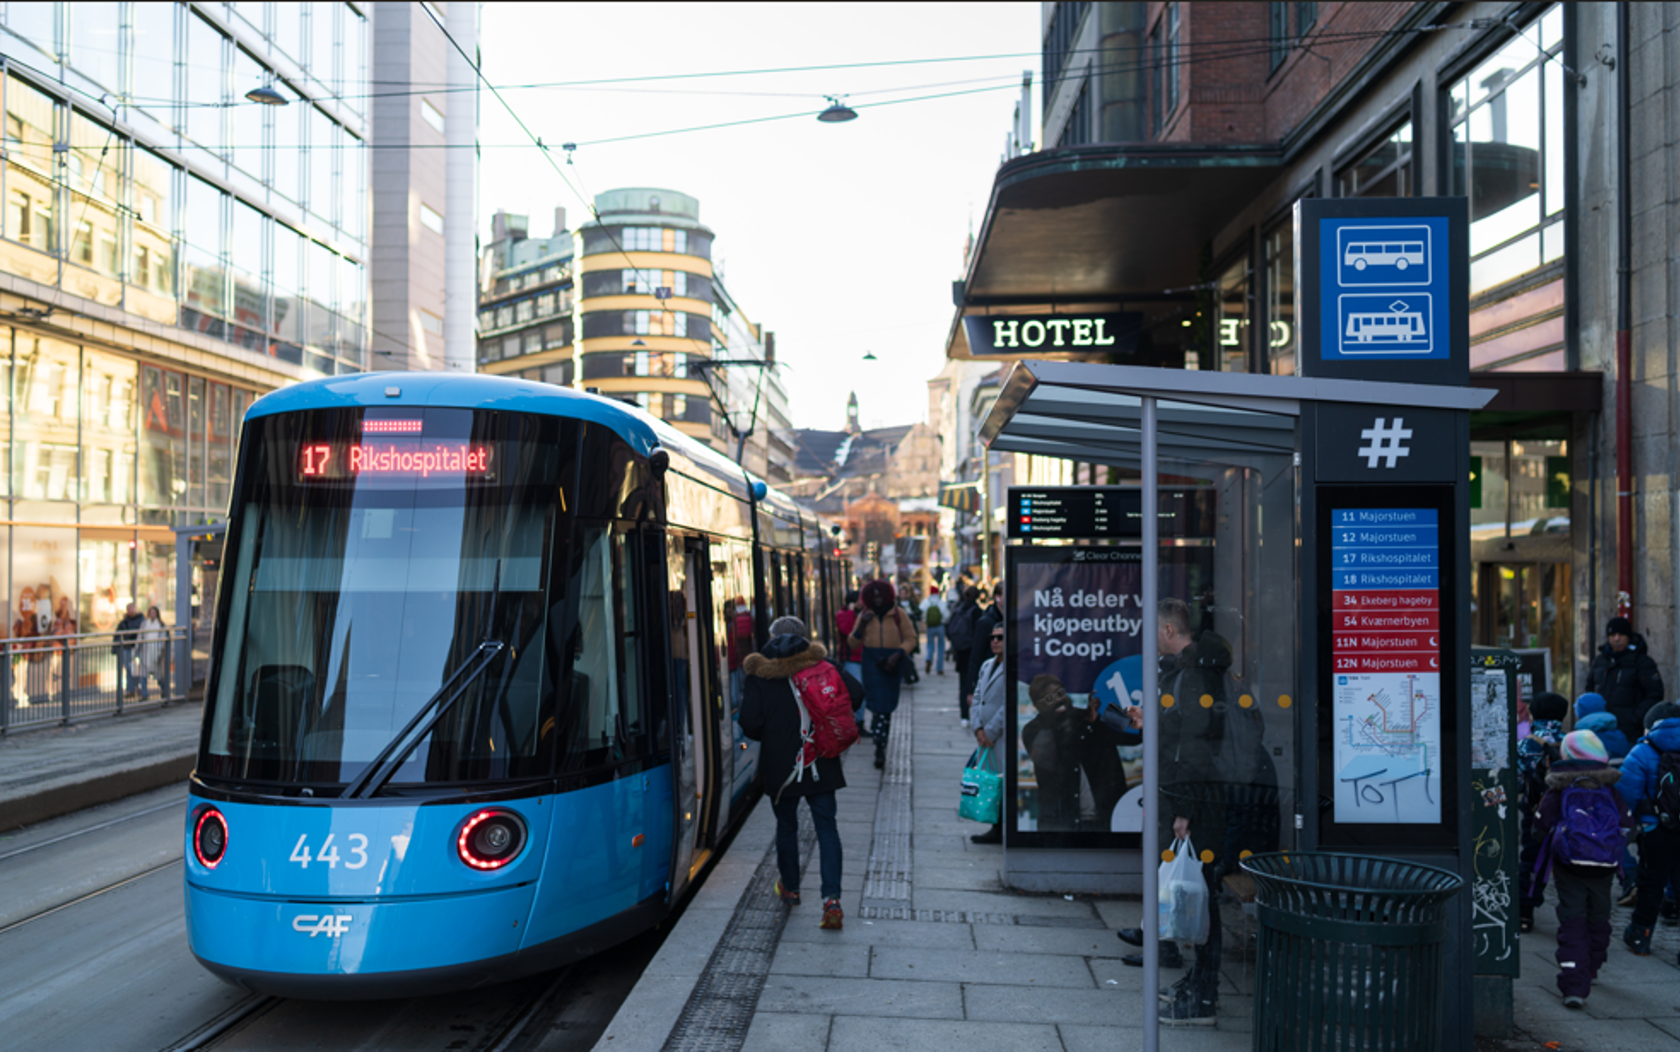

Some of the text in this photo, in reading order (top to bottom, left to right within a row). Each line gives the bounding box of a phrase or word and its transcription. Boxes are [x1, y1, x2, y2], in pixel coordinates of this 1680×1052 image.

[993, 318, 1115, 347] HOTEL
[303, 445, 487, 478] 17 Rikshospitalet
[1342, 511, 1416, 523] 11 Majorstuen
[1342, 532, 1417, 544] 12 Majorstuen
[1086, 551, 1143, 560] Clear Channe
[1343, 552, 1432, 564] 17 Rikshospitalet
[1343, 573, 1432, 585] 18 Rikshospitalet
[1033, 587, 1143, 608] Nå deler v
[1343, 595, 1433, 606] 34 Ekeberg hageby
[1033, 613, 1143, 636] kjøpeutby
[1343, 615, 1429, 627] 54 Kværnerbyen
[1033, 637, 1113, 661] i Coop!
[1337, 636, 1418, 649] 11N Majorstuen
[1337, 657, 1418, 670] 12N Majorstuen
[289, 832, 369, 870] 443
[292, 914, 353, 938] CAF
